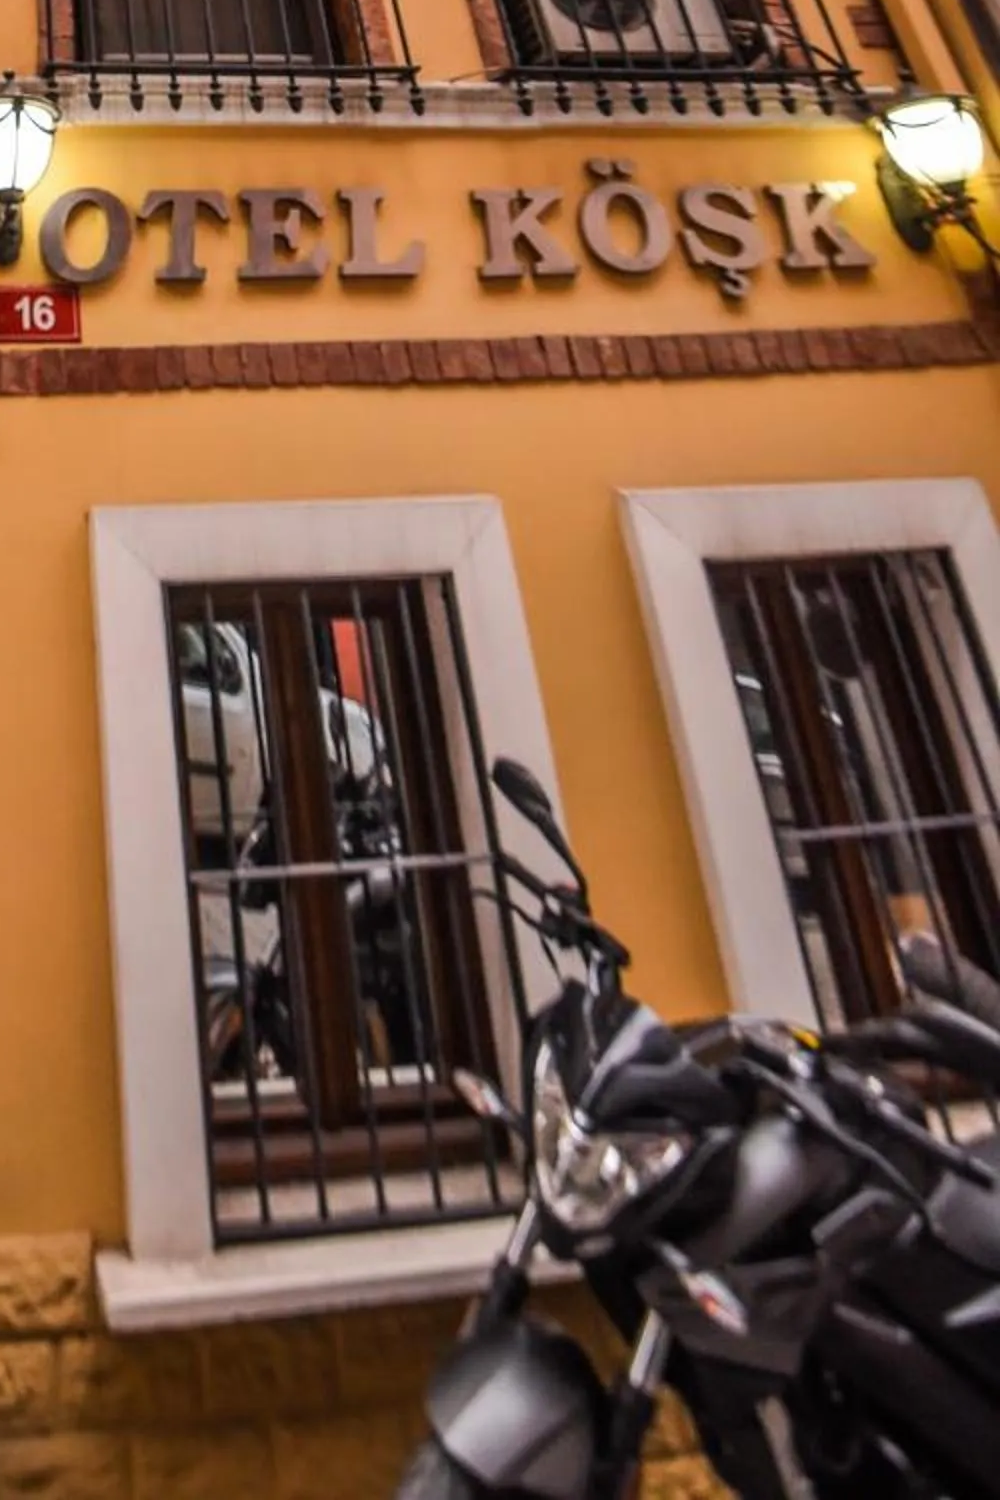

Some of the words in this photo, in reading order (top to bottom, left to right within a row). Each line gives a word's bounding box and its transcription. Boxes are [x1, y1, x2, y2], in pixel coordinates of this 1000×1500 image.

[38, 186, 427, 286] OTEL
[470, 156, 876, 304] KÖŞK
[14, 295, 56, 331] 16
